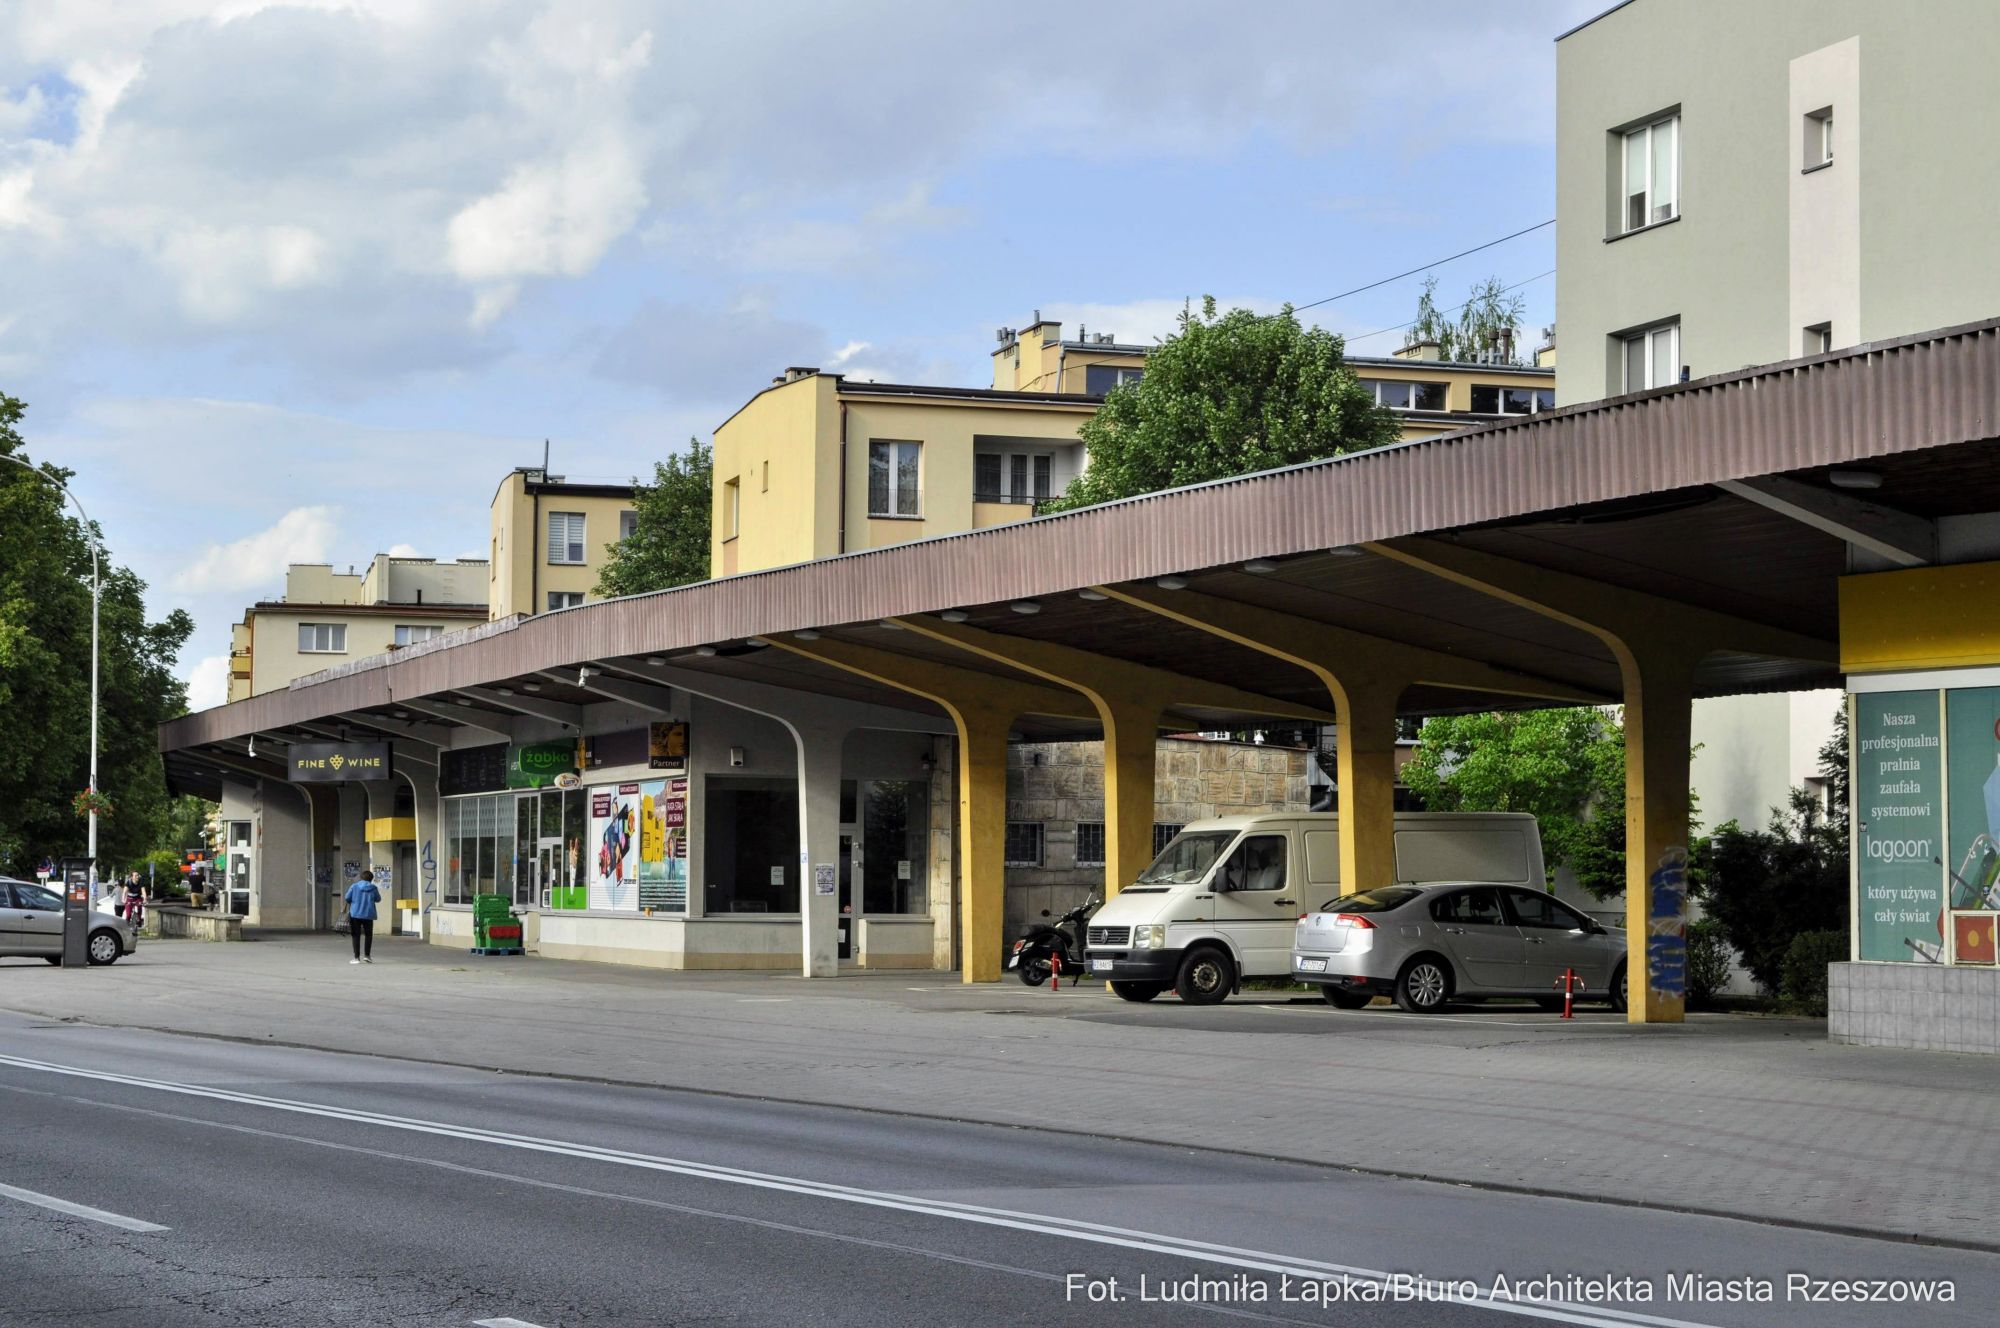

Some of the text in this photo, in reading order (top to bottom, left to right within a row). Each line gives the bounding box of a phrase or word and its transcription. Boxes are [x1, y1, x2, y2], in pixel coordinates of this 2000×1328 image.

[1883, 713, 1916, 726] Nasza
[1862, 734, 1939, 753] profesjonalna
[298, 758, 381, 769] FINE WINE
[526, 752, 569, 763] żabka
[653, 759, 681, 767] Partner
[1880, 757, 1921, 775] pralnia
[1880, 780, 1921, 795] zaufała
[1871, 803, 1931, 820] systemowi
[1867, 835, 1929, 863] lagoon
[1868, 885, 1937, 902] który używa
[1875, 909, 1931, 925] cały świat
